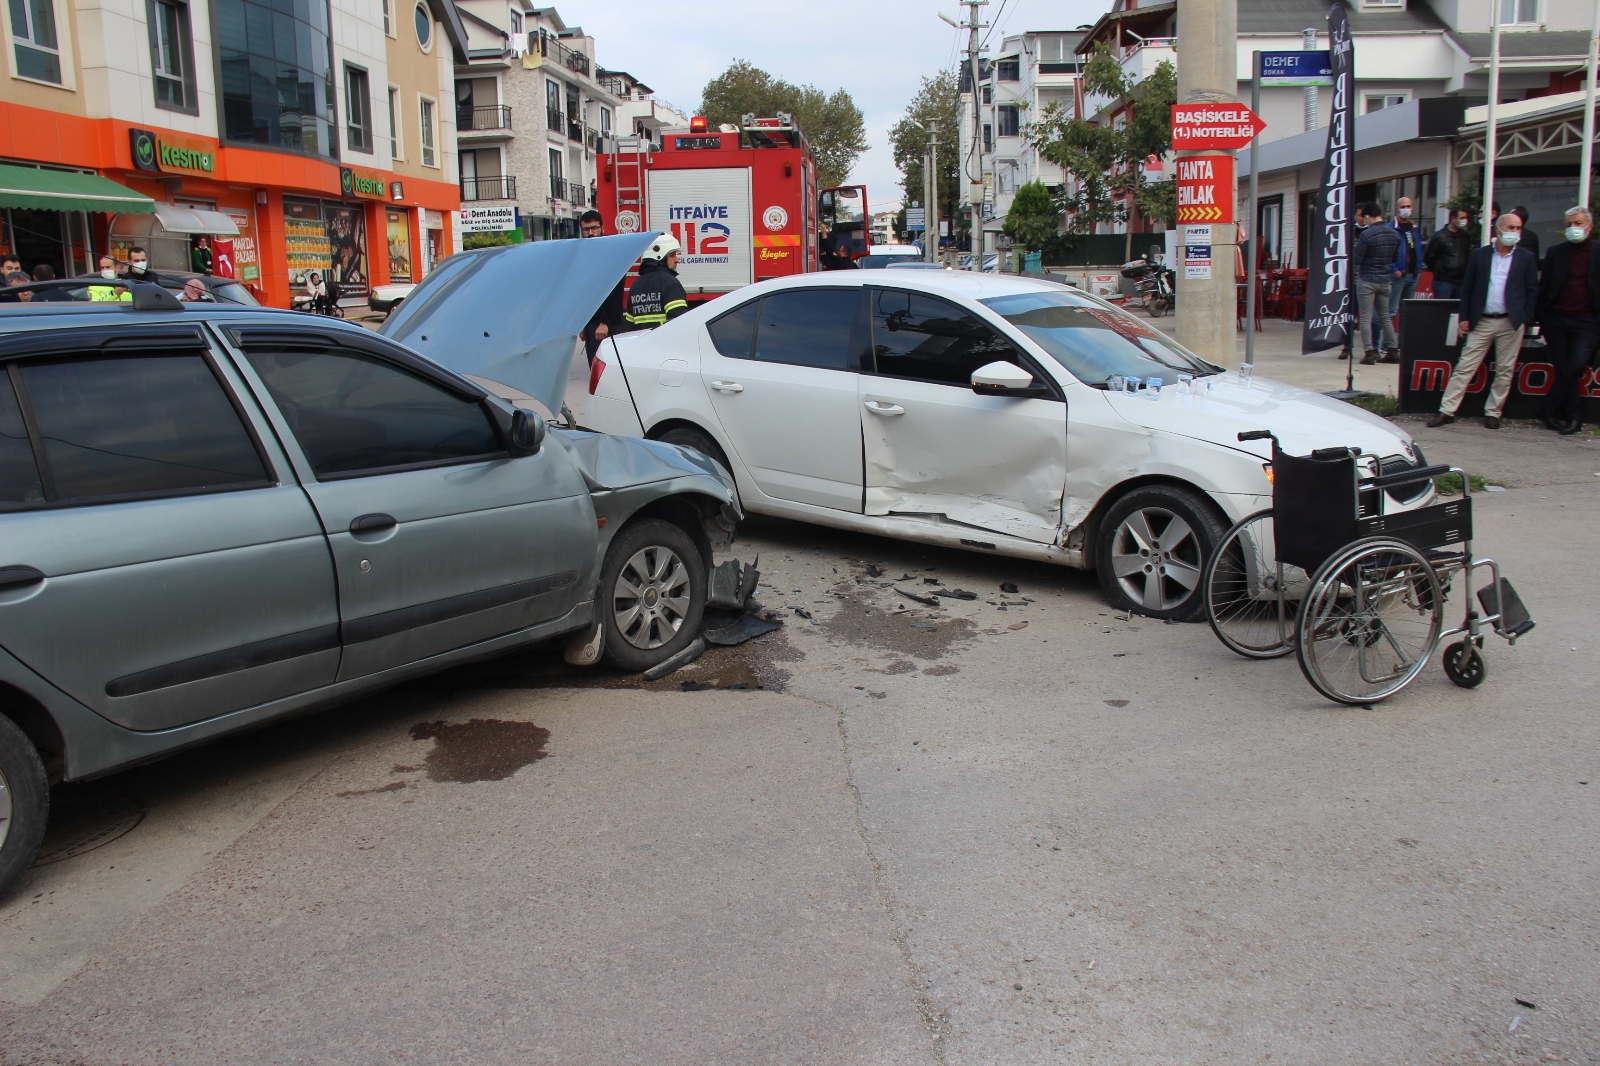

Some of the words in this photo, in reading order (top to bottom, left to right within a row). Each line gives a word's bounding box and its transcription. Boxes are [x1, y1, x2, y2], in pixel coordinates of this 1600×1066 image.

[1264, 56, 1300, 67] DEMET
[1175, 108, 1250, 126] BAŞİSKELE
[1173, 127, 1191, 140] (1.)
[1192, 124, 1254, 138] NOTERLİĞİ
[159, 139, 215, 172] kesmar
[1179, 160, 1214, 181] TANTA
[353, 172, 385, 196] kesmar
[1178, 185, 1215, 206] EMLAK
[471, 210, 486, 218] Dent
[487, 208, 512, 217] Anadolu
[669, 204, 729, 219] İTFAİYE
[670, 222, 731, 255] 112
[235, 250, 256, 263] PAZAR!
[677, 256, 686, 264] CİL
[687, 256, 704, 265] ÇAĞRI
[704, 256, 729, 264] MERKEZİ
[760, 248, 789, 261] Ziegler
[631, 292, 661, 304] KOCAELİ
[632, 303, 662, 315] İTFAİYESİ
